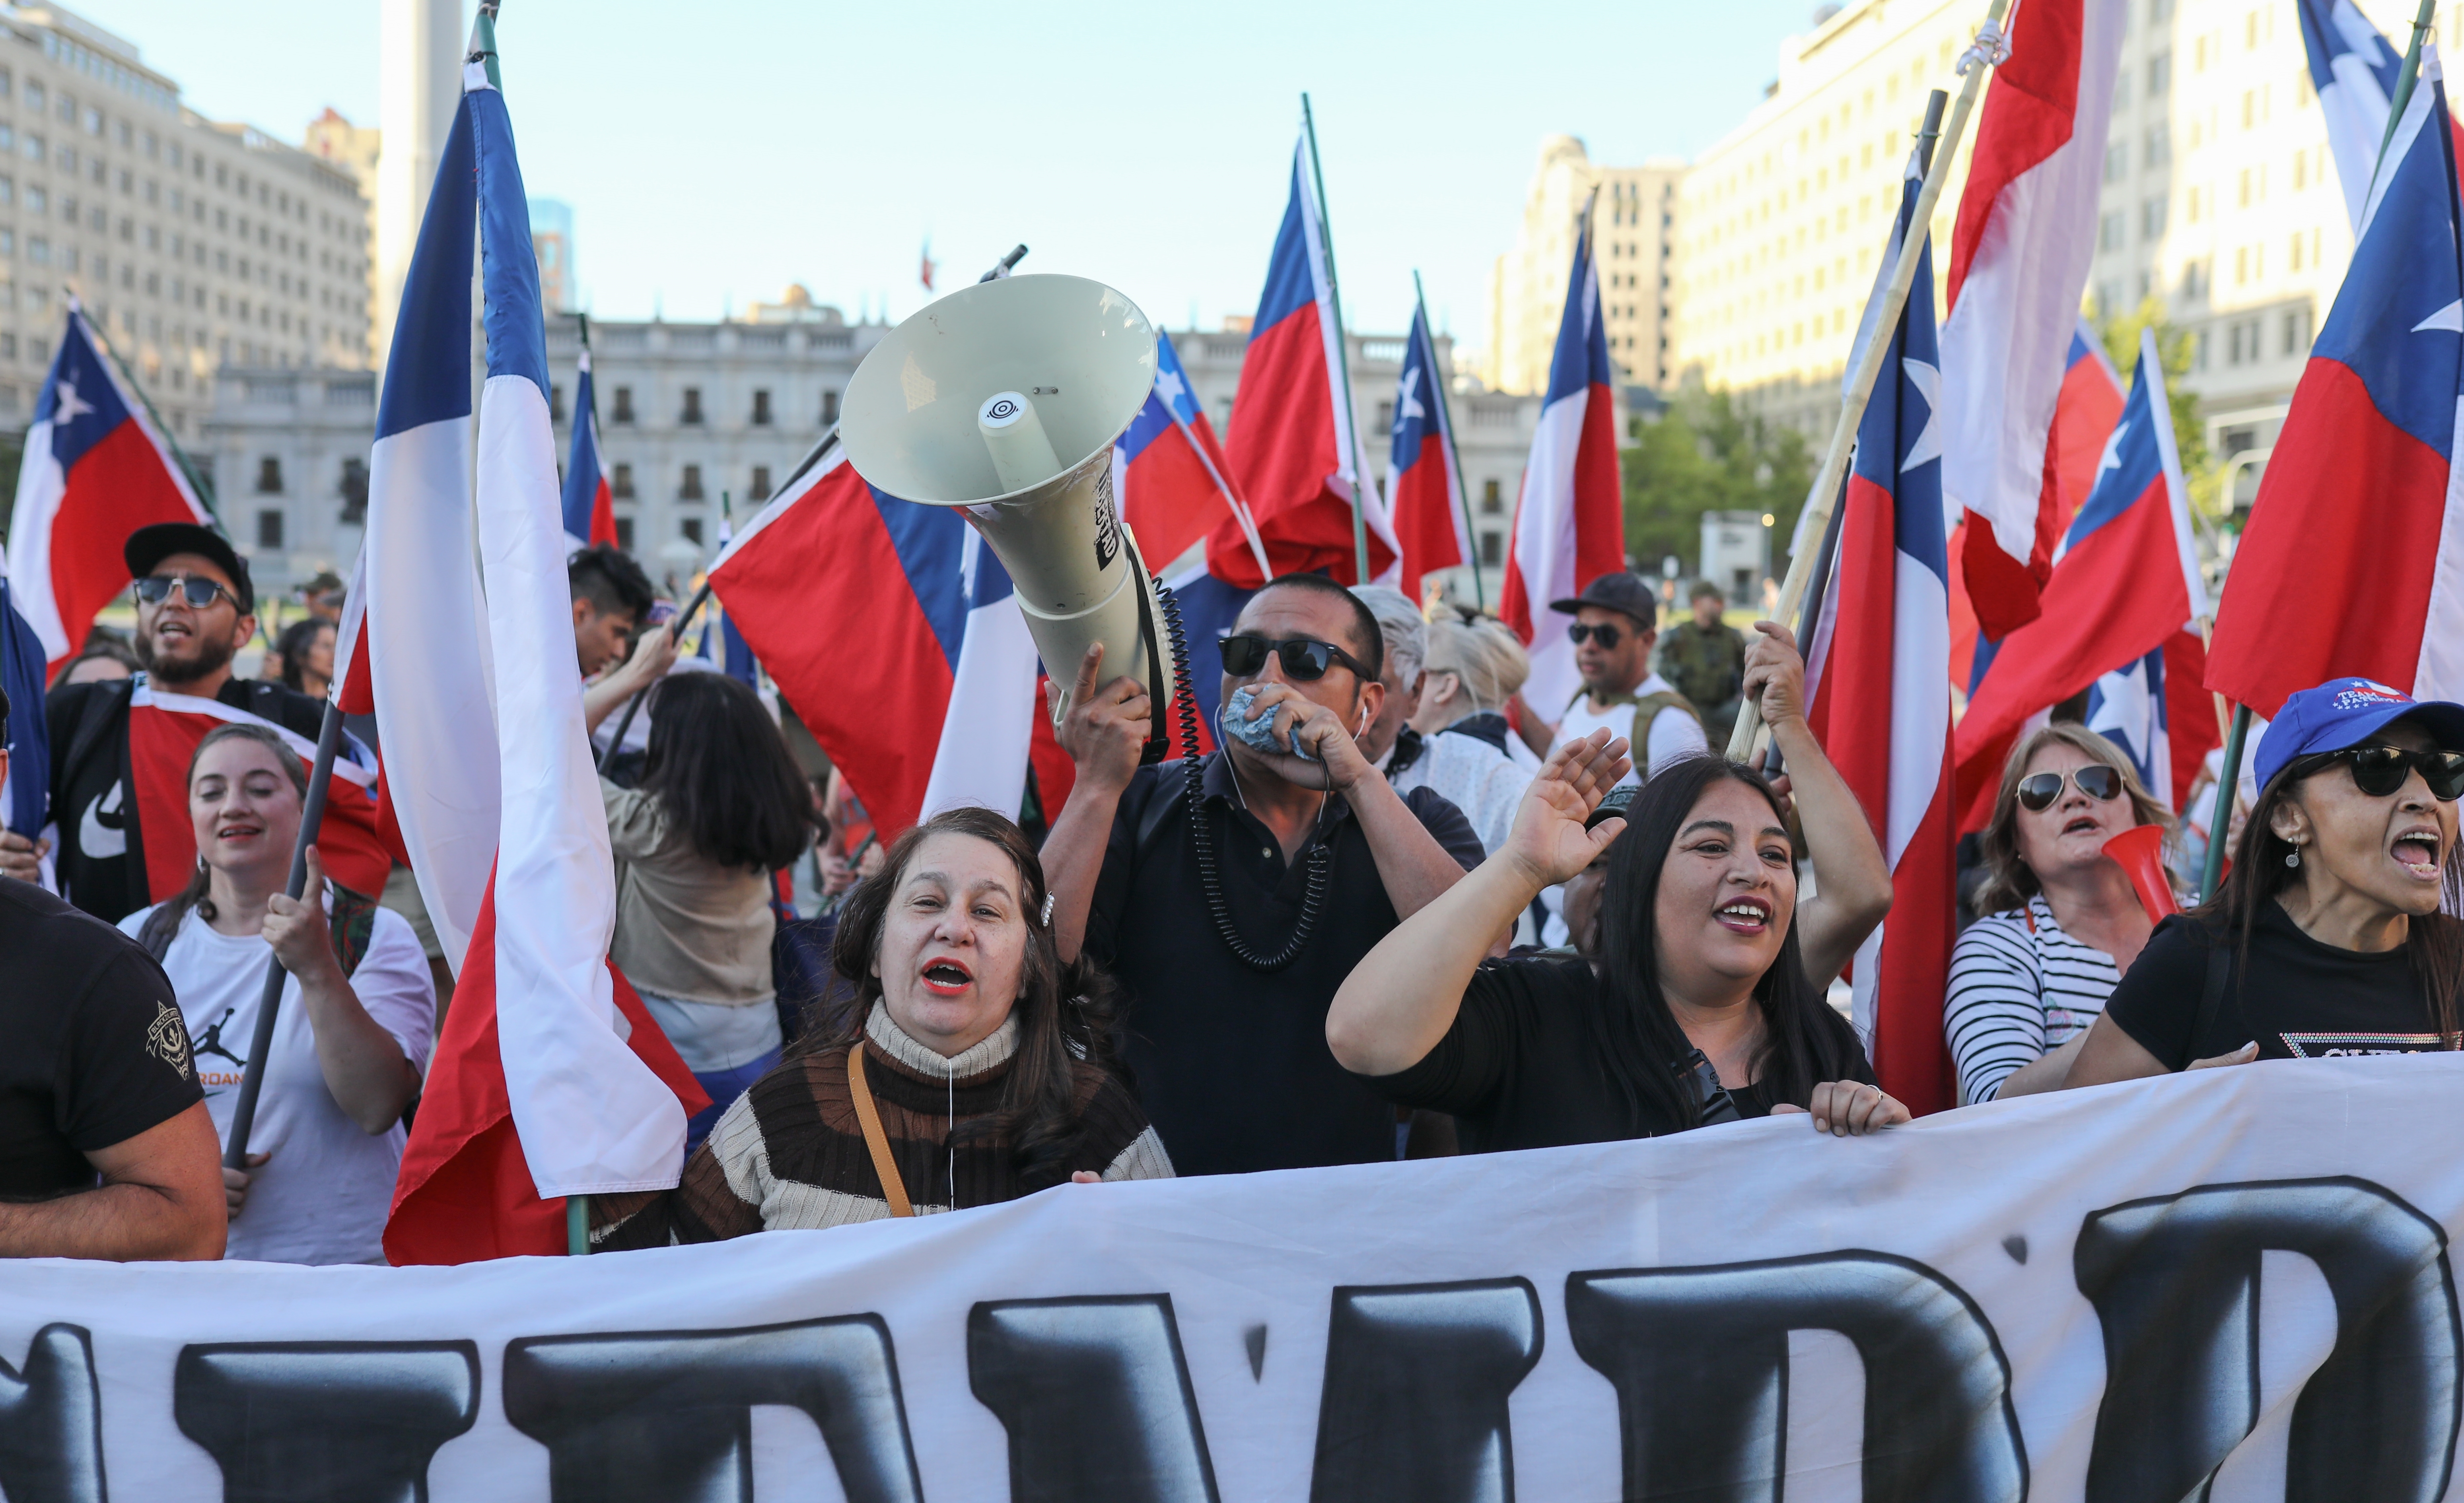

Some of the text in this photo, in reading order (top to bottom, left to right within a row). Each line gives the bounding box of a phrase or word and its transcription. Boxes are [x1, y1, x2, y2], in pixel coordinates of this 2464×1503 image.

[1096, 472, 1116, 558] LIBERTAD
[1112, 518, 1117, 530] de
[2338, 691, 2378, 699] TEAM
[198, 1072, 245, 1085] RDAN
